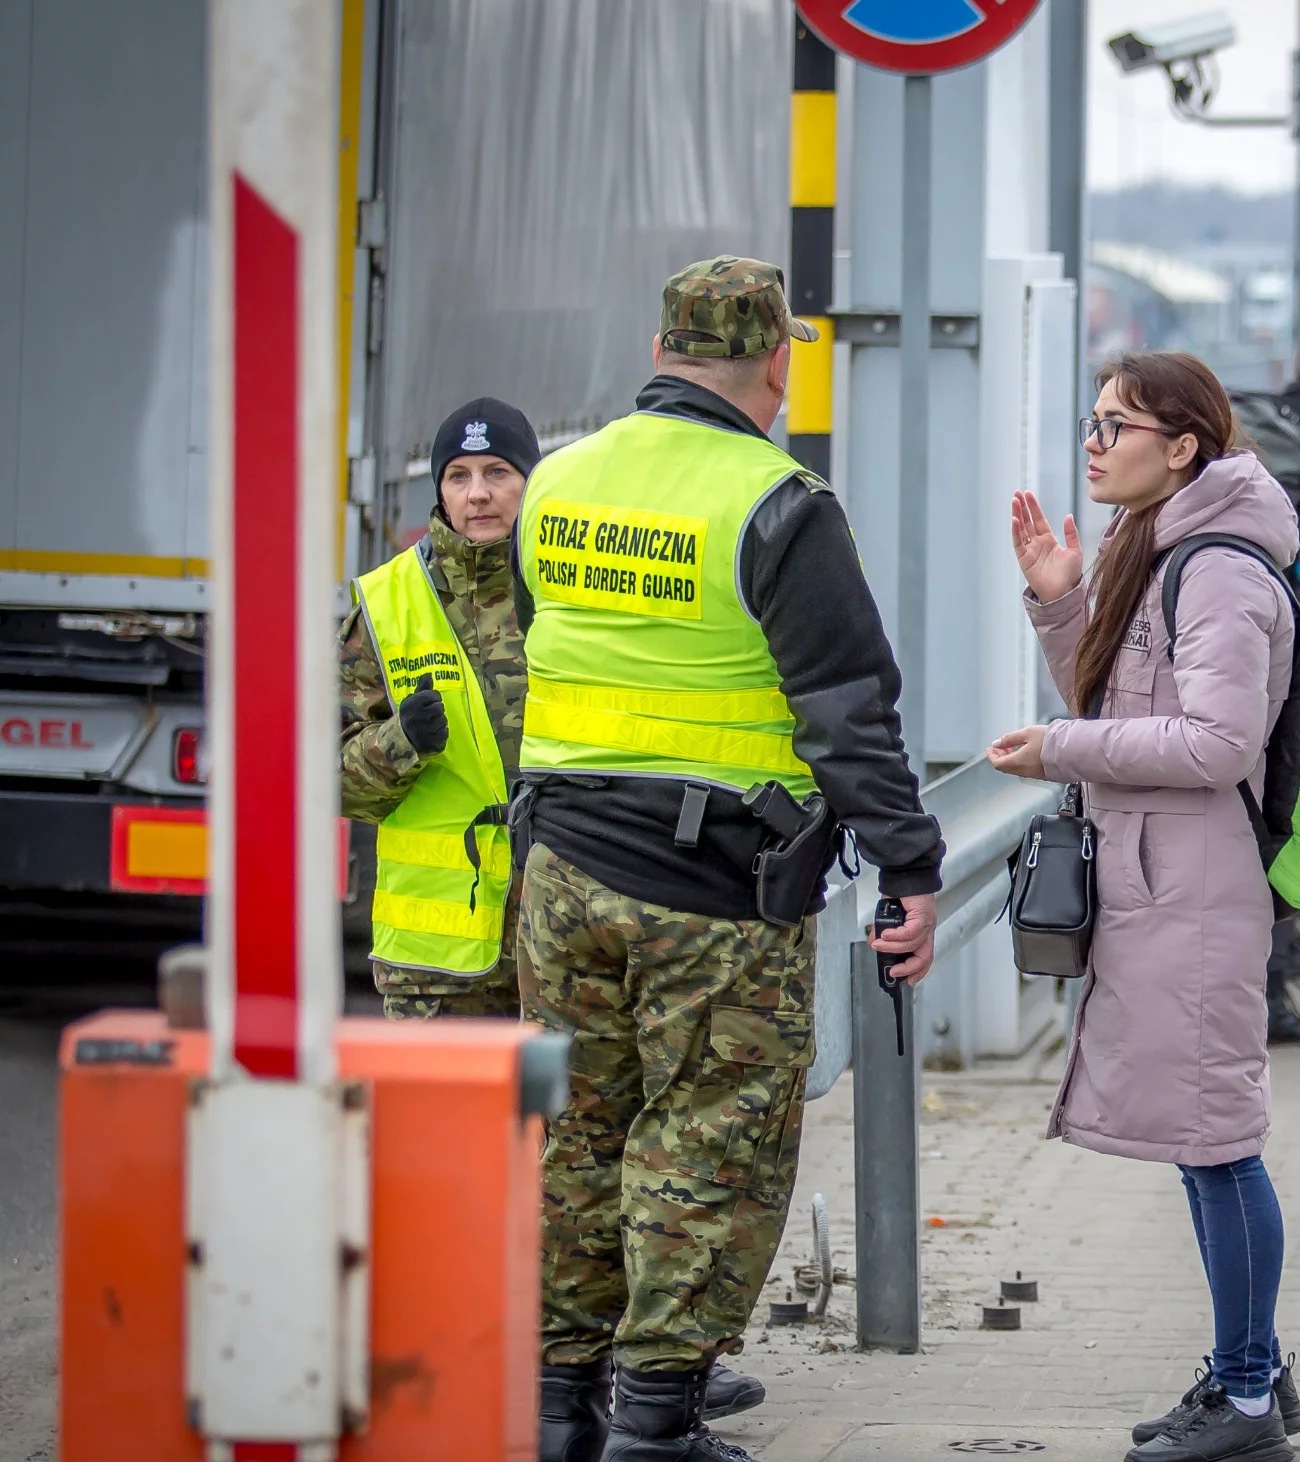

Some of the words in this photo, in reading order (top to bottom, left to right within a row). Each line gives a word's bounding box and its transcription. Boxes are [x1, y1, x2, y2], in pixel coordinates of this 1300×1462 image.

[539, 514, 589, 550] STRAŻ
[595, 522, 696, 565] GRANICZNA
[538, 558, 577, 587] POLISH
[584, 565, 637, 595] BORDER
[642, 573, 695, 602] GUARD
[408, 652, 458, 672] GRANICZNA
[435, 670, 460, 681] GUARD
[0, 716, 95, 750] GEL
